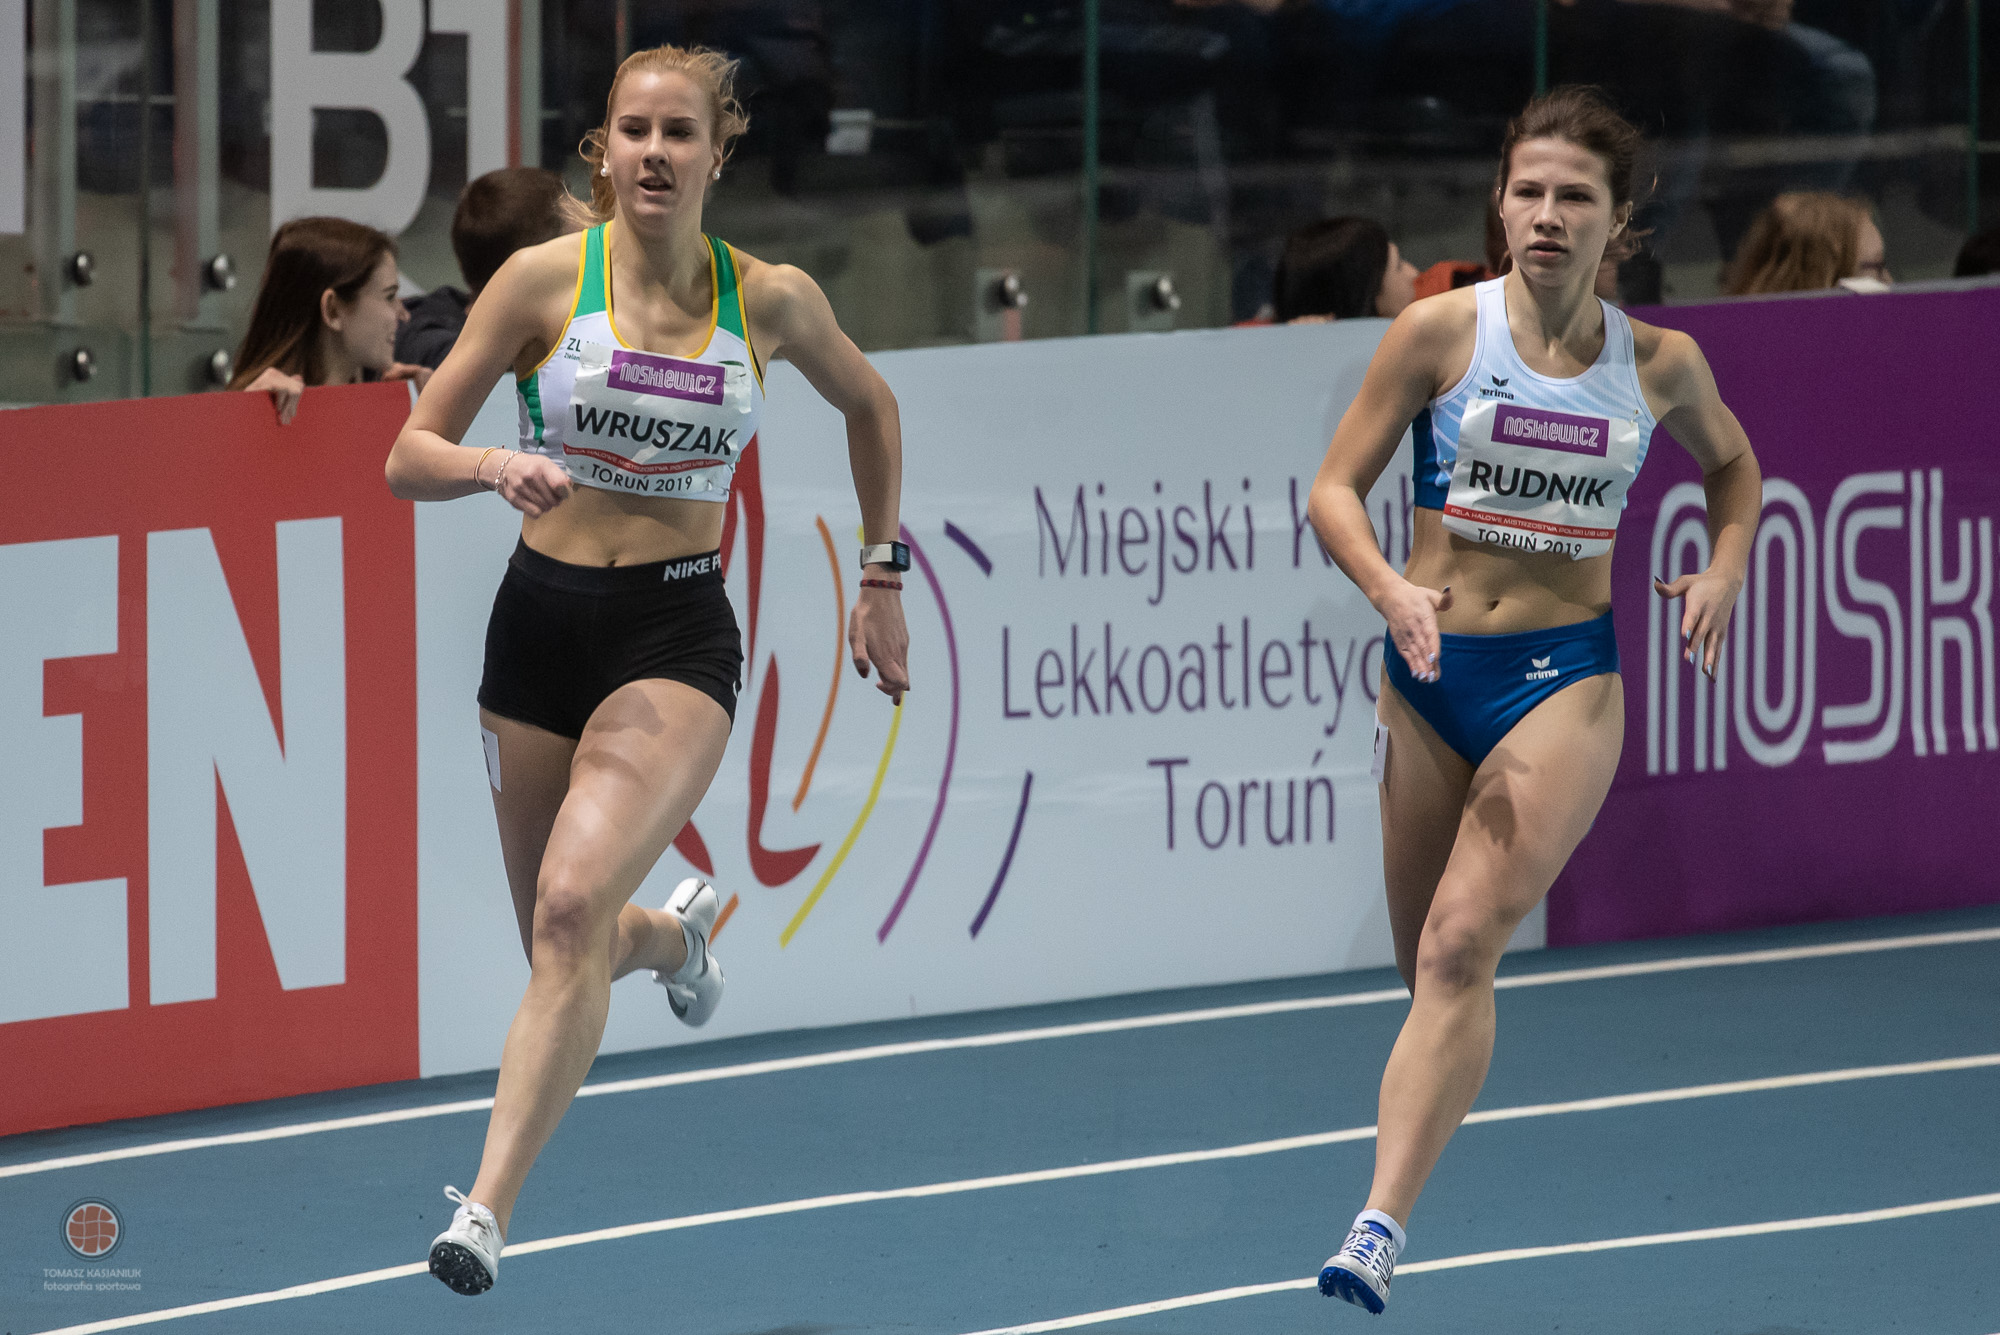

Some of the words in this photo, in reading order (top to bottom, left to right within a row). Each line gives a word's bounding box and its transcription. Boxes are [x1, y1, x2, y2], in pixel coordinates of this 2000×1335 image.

[619, 362, 718, 396] noskiewicz
[1482, 388, 1515, 400] erima
[575, 403, 738, 456] WRUSZAK
[1503, 415, 1600, 448] noskiewicz
[590, 463, 650, 492] TORUŃ
[654, 475, 693, 492] 2019
[1468, 459, 1614, 508] RUDNIK
[1450, 507, 1470, 518] PZLA
[1471, 512, 1503, 524] HALOWE
[1503, 517, 1558, 532] MISTRZOSTWA
[1558, 527, 1584, 536] POLSKI
[1033, 477, 1254, 606] Miejski
[1477, 527, 1538, 551] TORUŃ
[1543, 539, 1583, 558] 2019
[663, 557, 710, 582] NIKE
[1525, 669, 1559, 681] erima
[0, 515, 348, 1025] EN
[1146, 748, 1336, 851] Toruń
